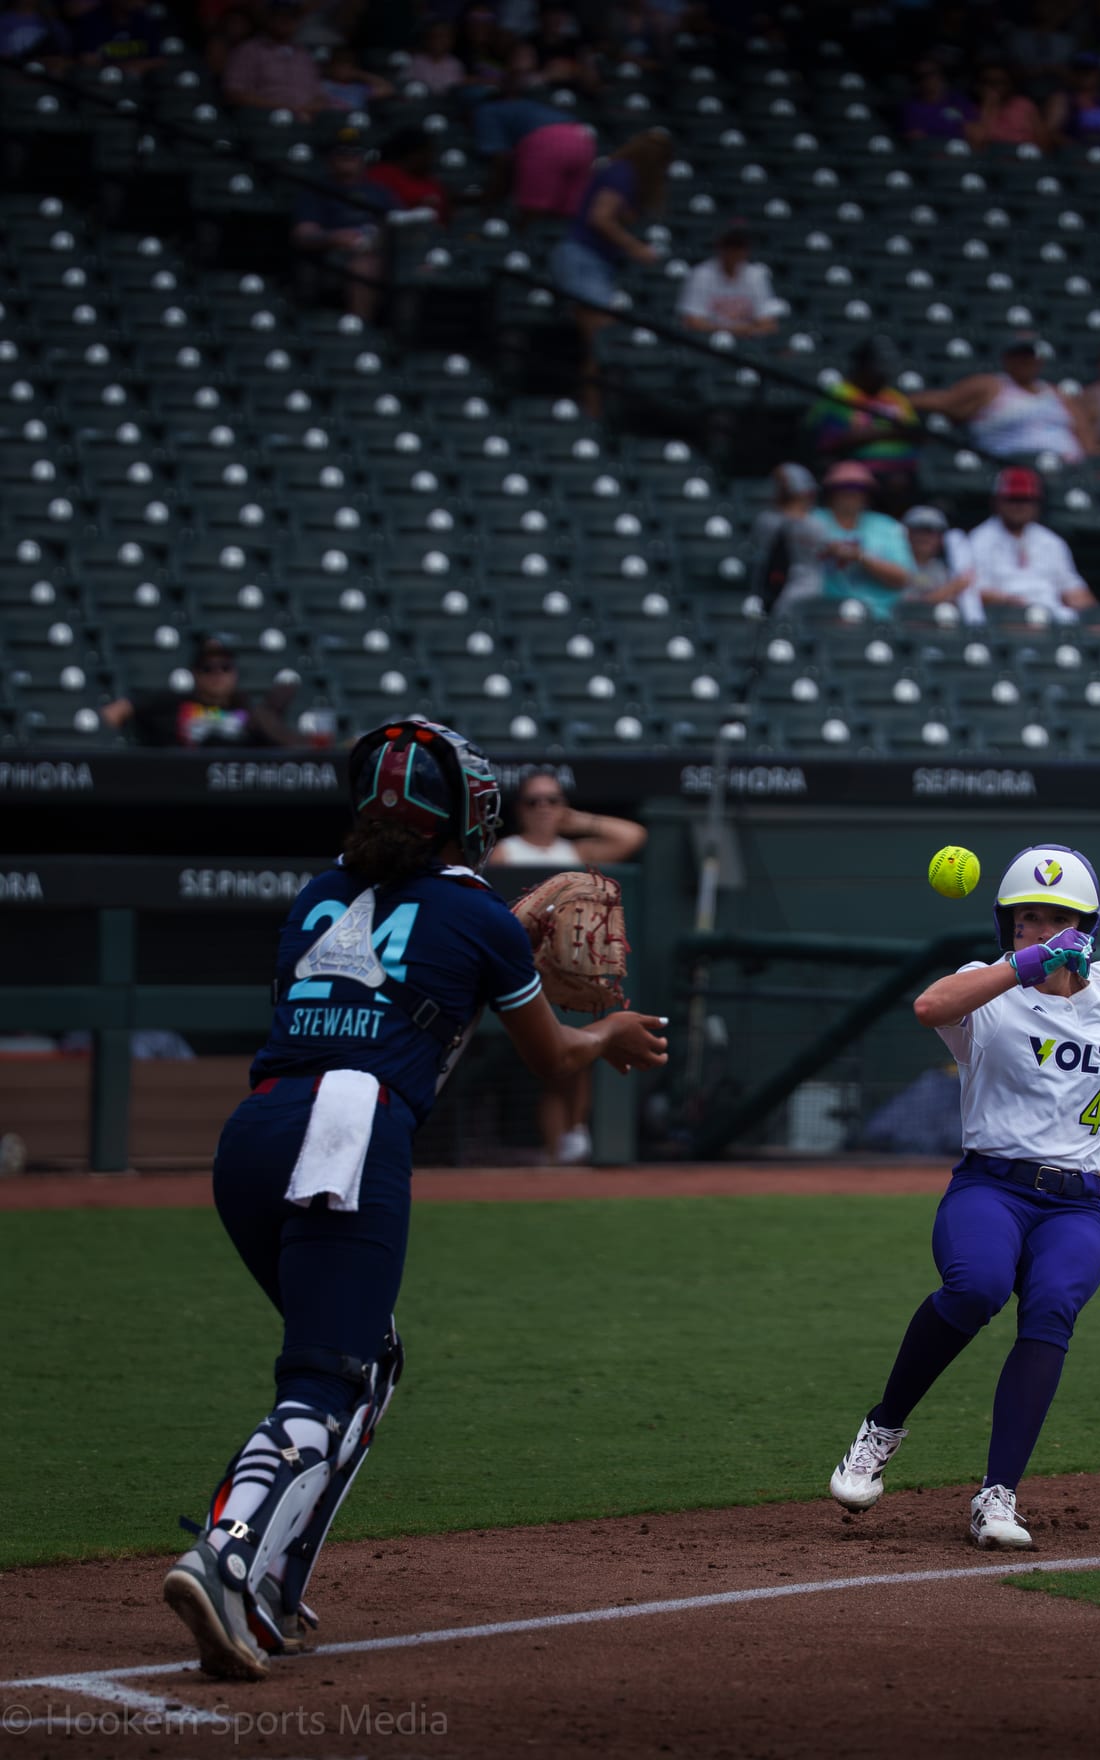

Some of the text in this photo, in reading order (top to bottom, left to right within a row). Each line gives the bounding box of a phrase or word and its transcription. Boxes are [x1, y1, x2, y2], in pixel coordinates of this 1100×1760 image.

[207, 762, 339, 791] SEPHORA
[911, 767, 1036, 797] SEPHORA
[287, 899, 421, 1005] 24
[288, 1007, 386, 1039] STEWART
